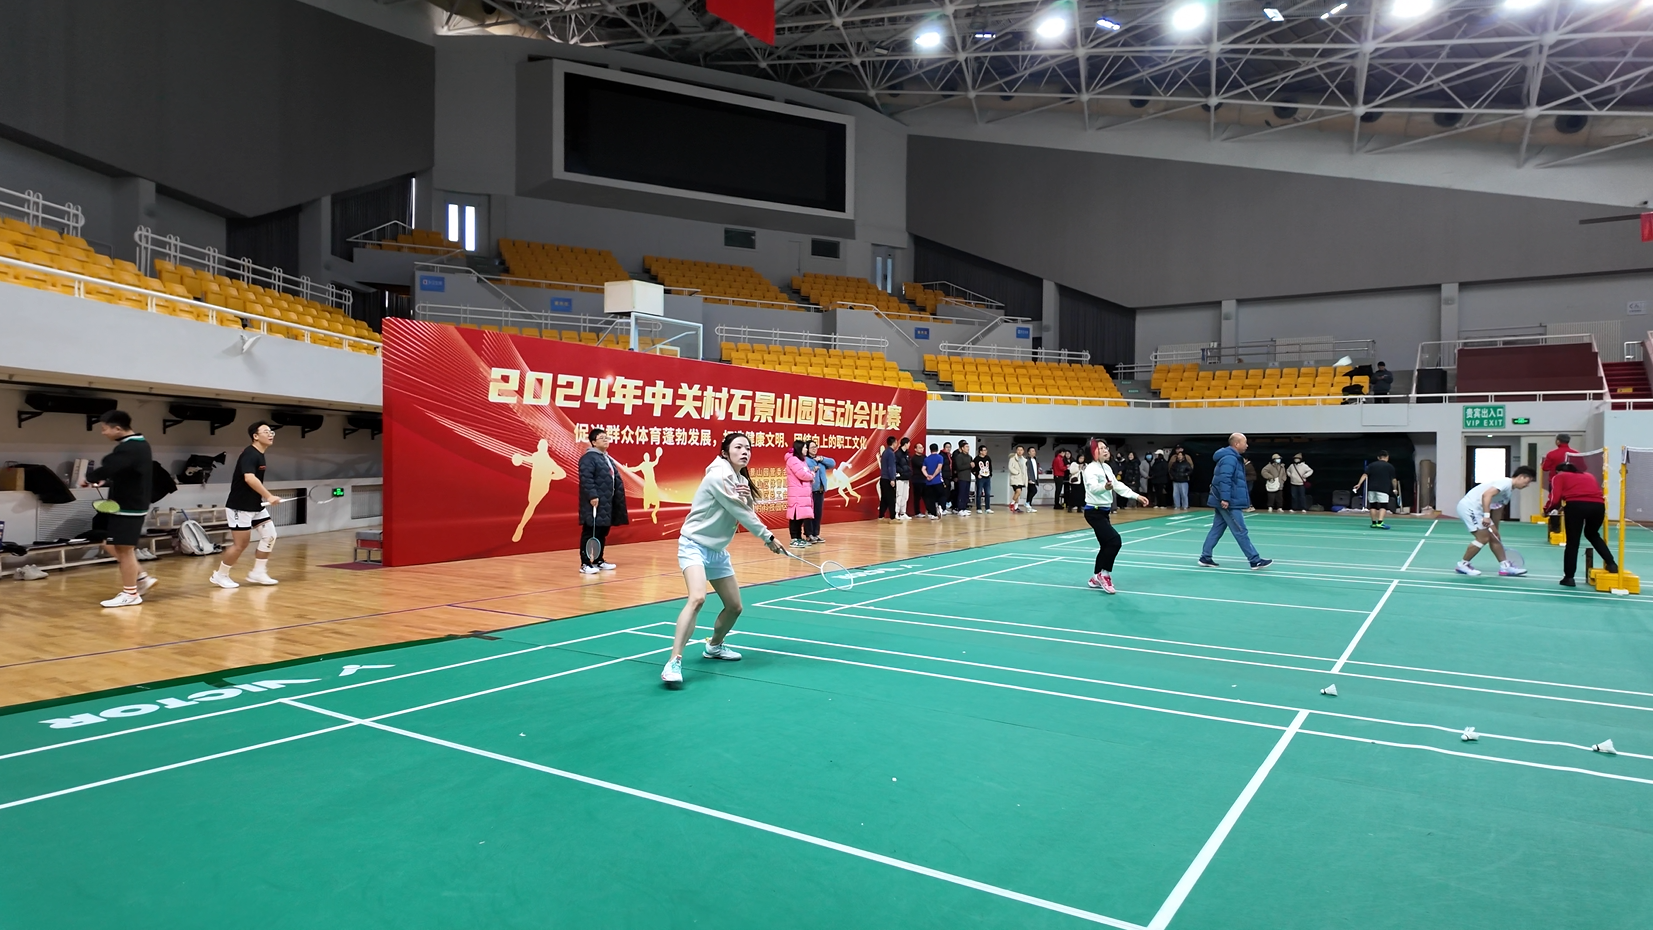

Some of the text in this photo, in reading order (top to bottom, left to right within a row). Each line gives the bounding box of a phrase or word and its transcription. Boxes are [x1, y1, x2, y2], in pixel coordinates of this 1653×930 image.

[488, 367, 903, 431] 2024年中关村石景山园运动会比赛
[1466, 408, 1504, 419] 贵宾出入口
[1483, 419, 1503, 427] EXIT
[38, 678, 322, 729] VICTOR
